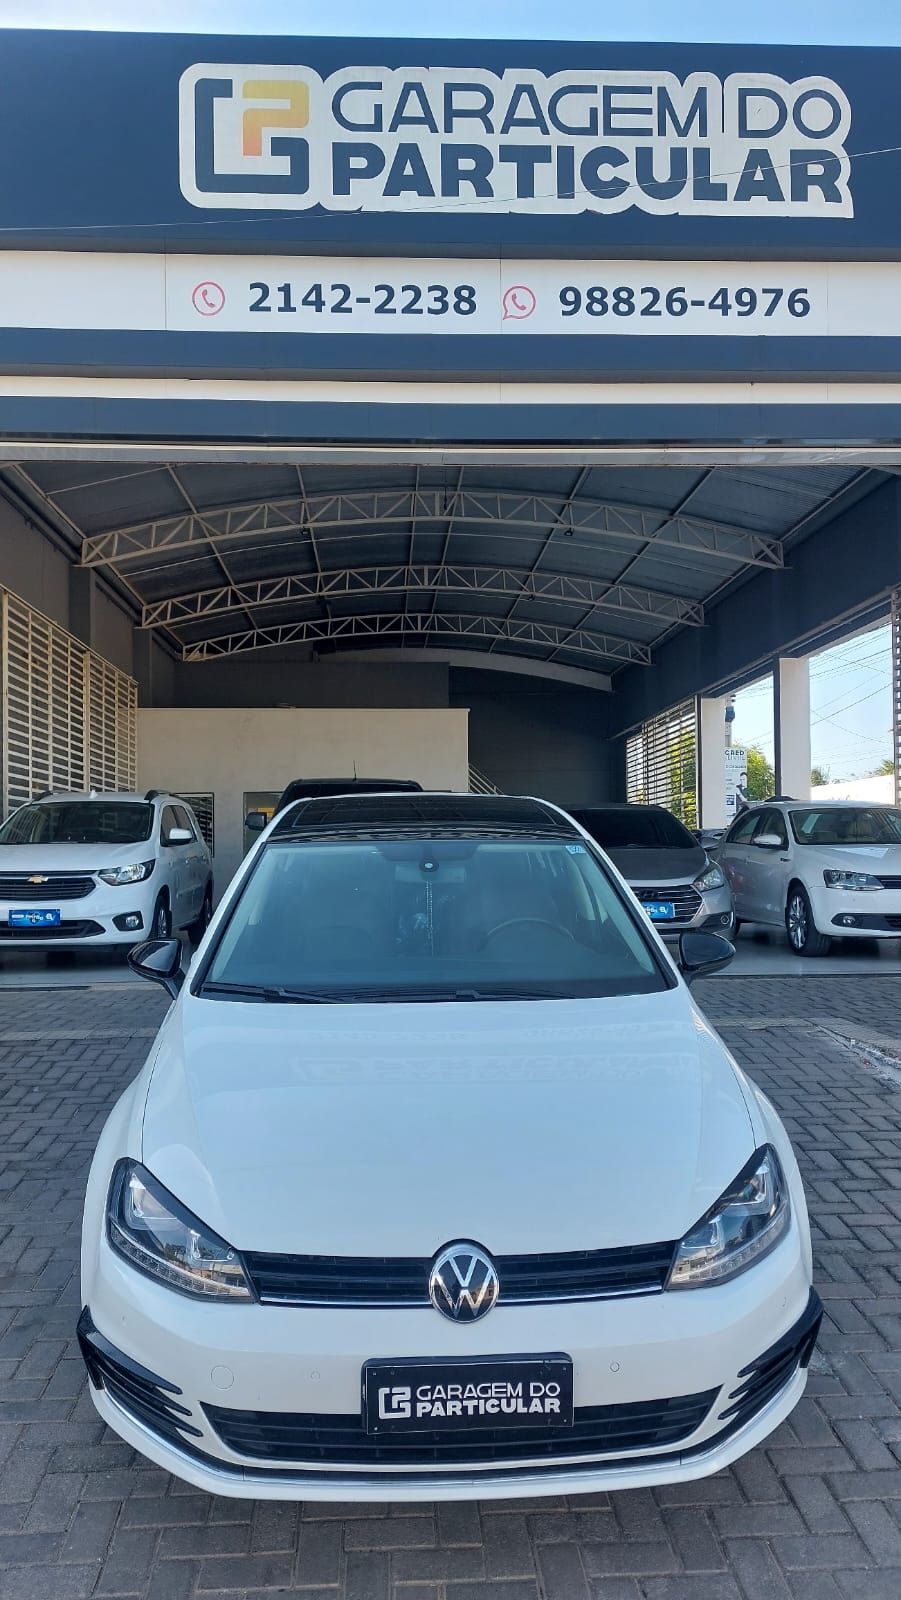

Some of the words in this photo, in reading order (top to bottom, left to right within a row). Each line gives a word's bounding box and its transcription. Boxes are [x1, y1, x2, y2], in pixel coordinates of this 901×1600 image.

[332, 82, 708, 138] GARAGEM
[738, 88, 842, 140] DO
[332, 143, 843, 204] PARTICULAR
[249, 281, 477, 316] 2142-2238
[559, 286, 811, 318] 98826-4976
[416, 1383, 522, 1400] GARAGEM
[530, 1383, 560, 1397] DO
[416, 1398, 560, 1417] PARTICULAR
